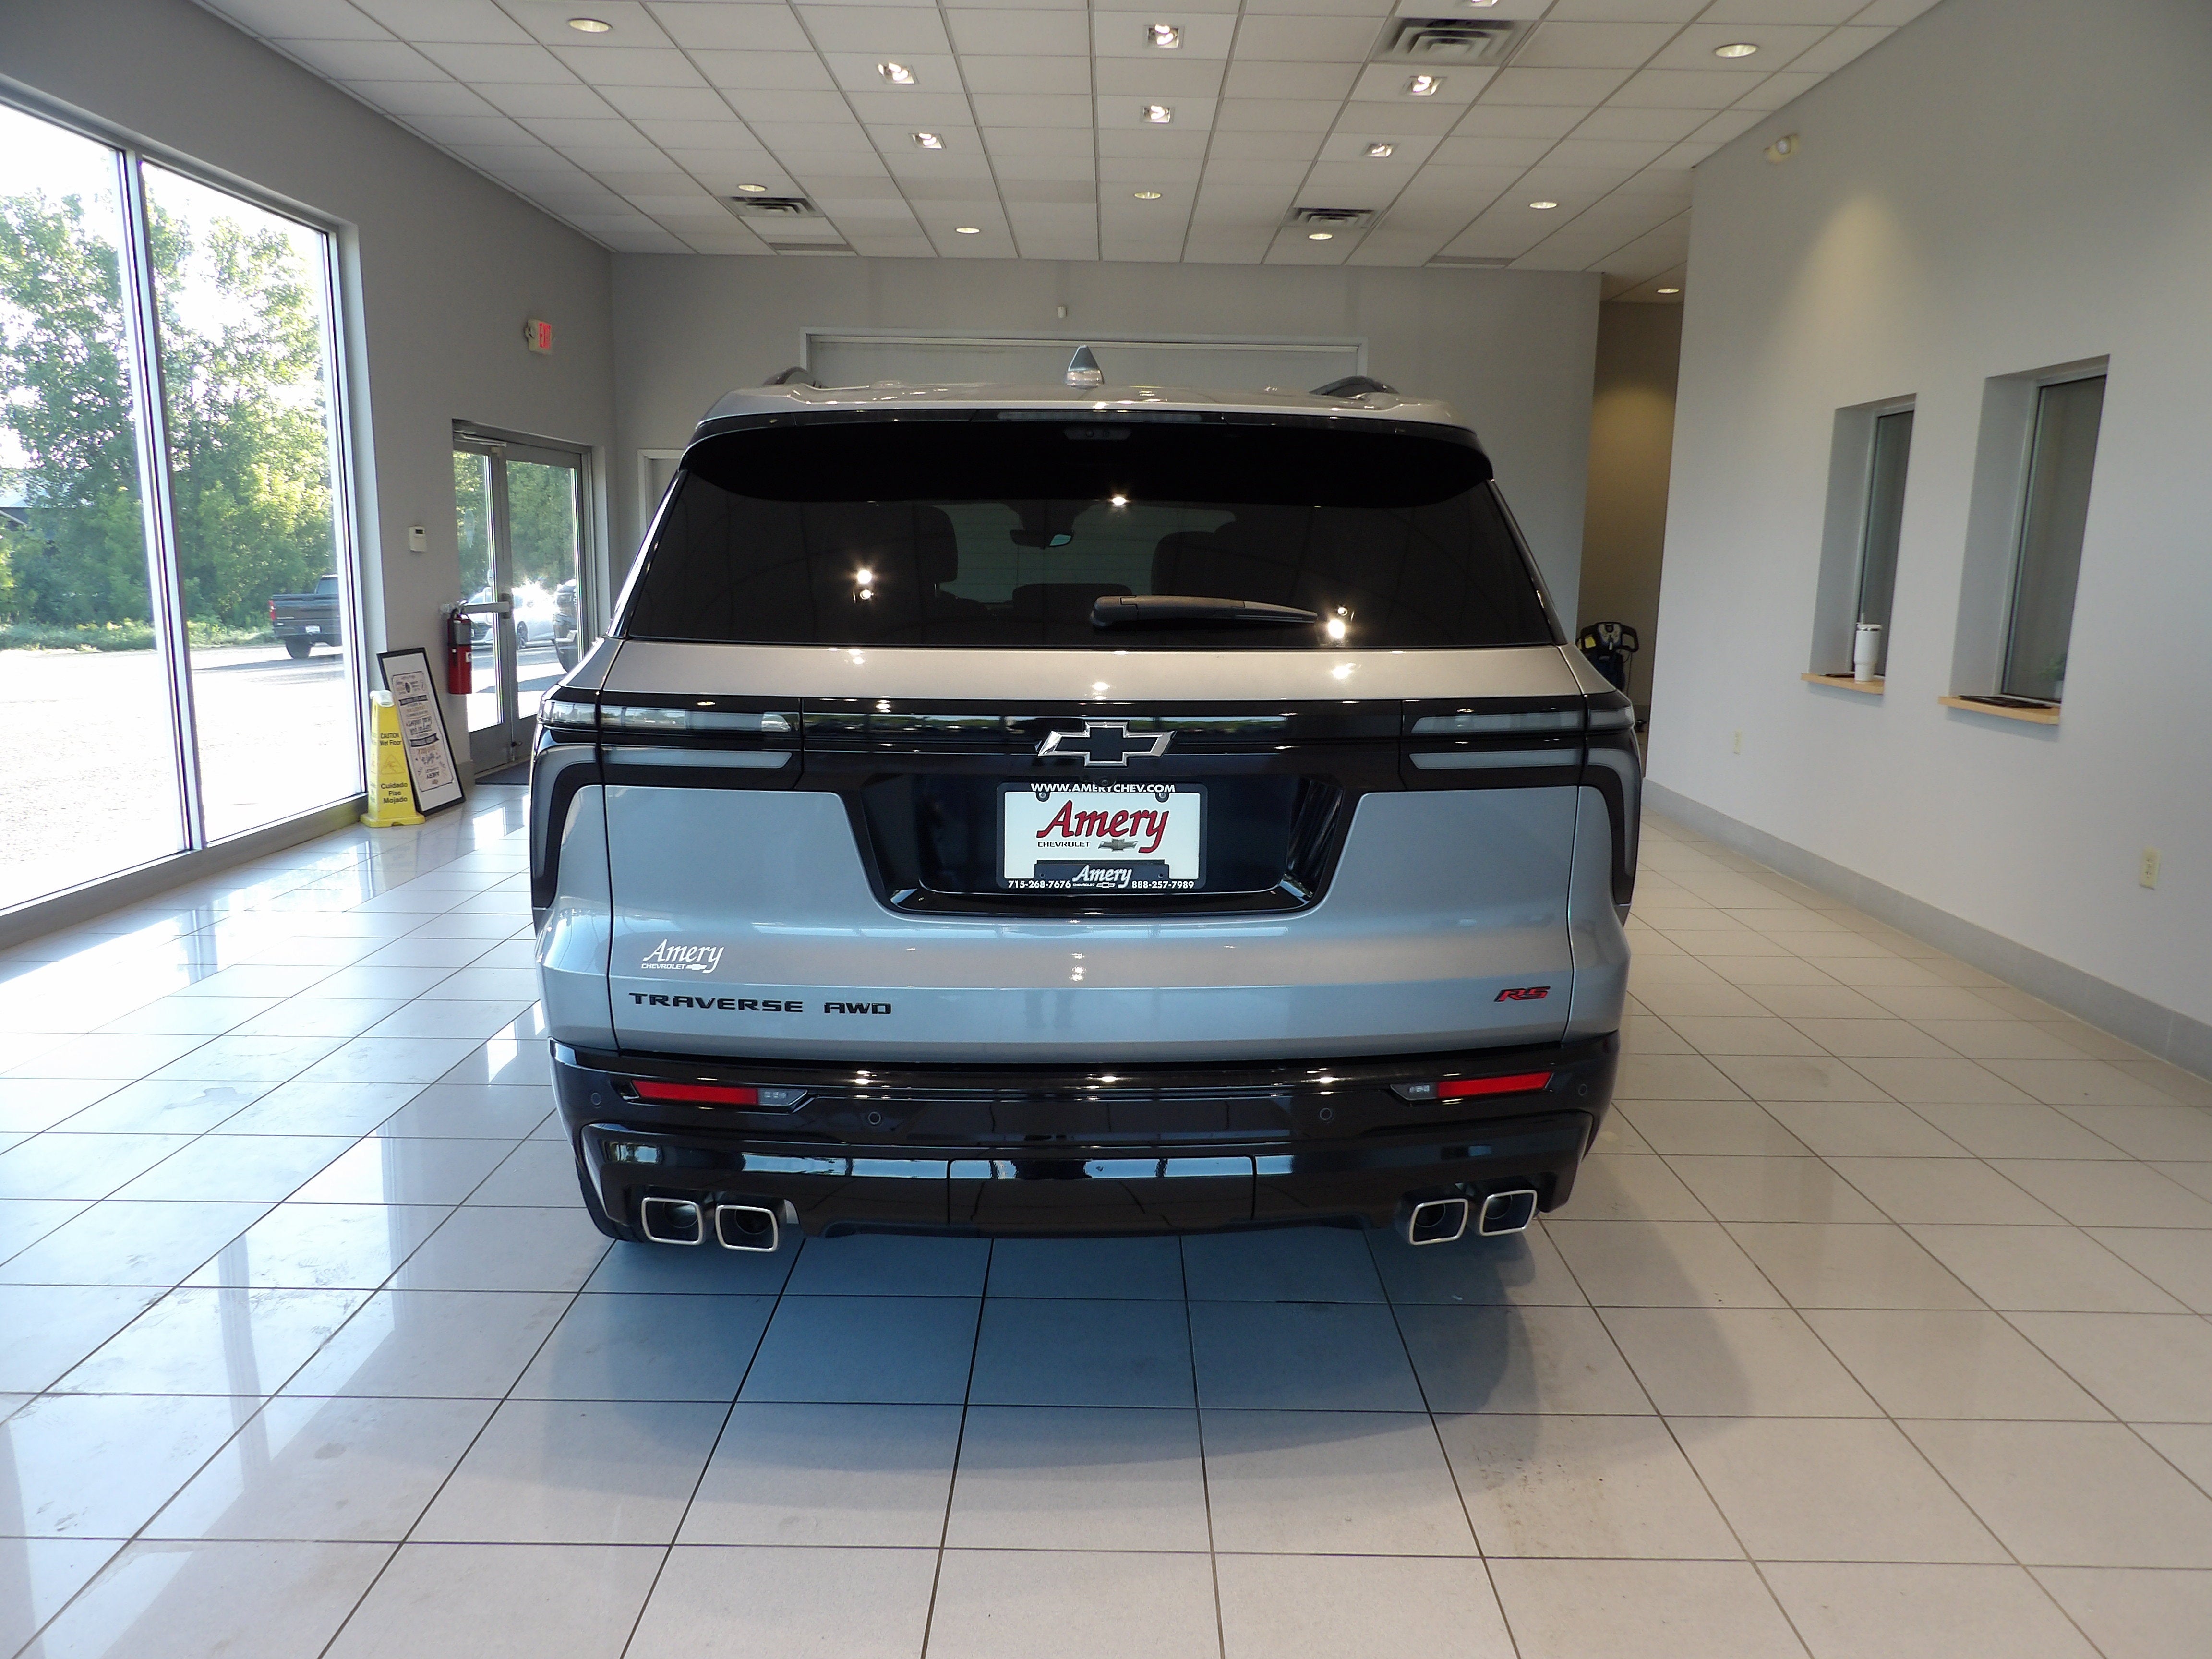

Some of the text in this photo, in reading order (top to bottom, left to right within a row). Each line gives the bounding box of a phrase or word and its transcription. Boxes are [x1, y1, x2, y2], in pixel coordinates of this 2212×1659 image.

[1036, 799, 1170, 854] Amery
[1008, 880, 1071, 889] 715-268-7676
[1072, 864, 1132, 889] Amery
[1131, 880, 1194, 889] 888-257-7989
[642, 938, 724, 974] Amery
[628, 992, 803, 1013] TRAVERSE
[1494, 986, 1551, 1002] RS
[824, 1001, 892, 1015] AWD
